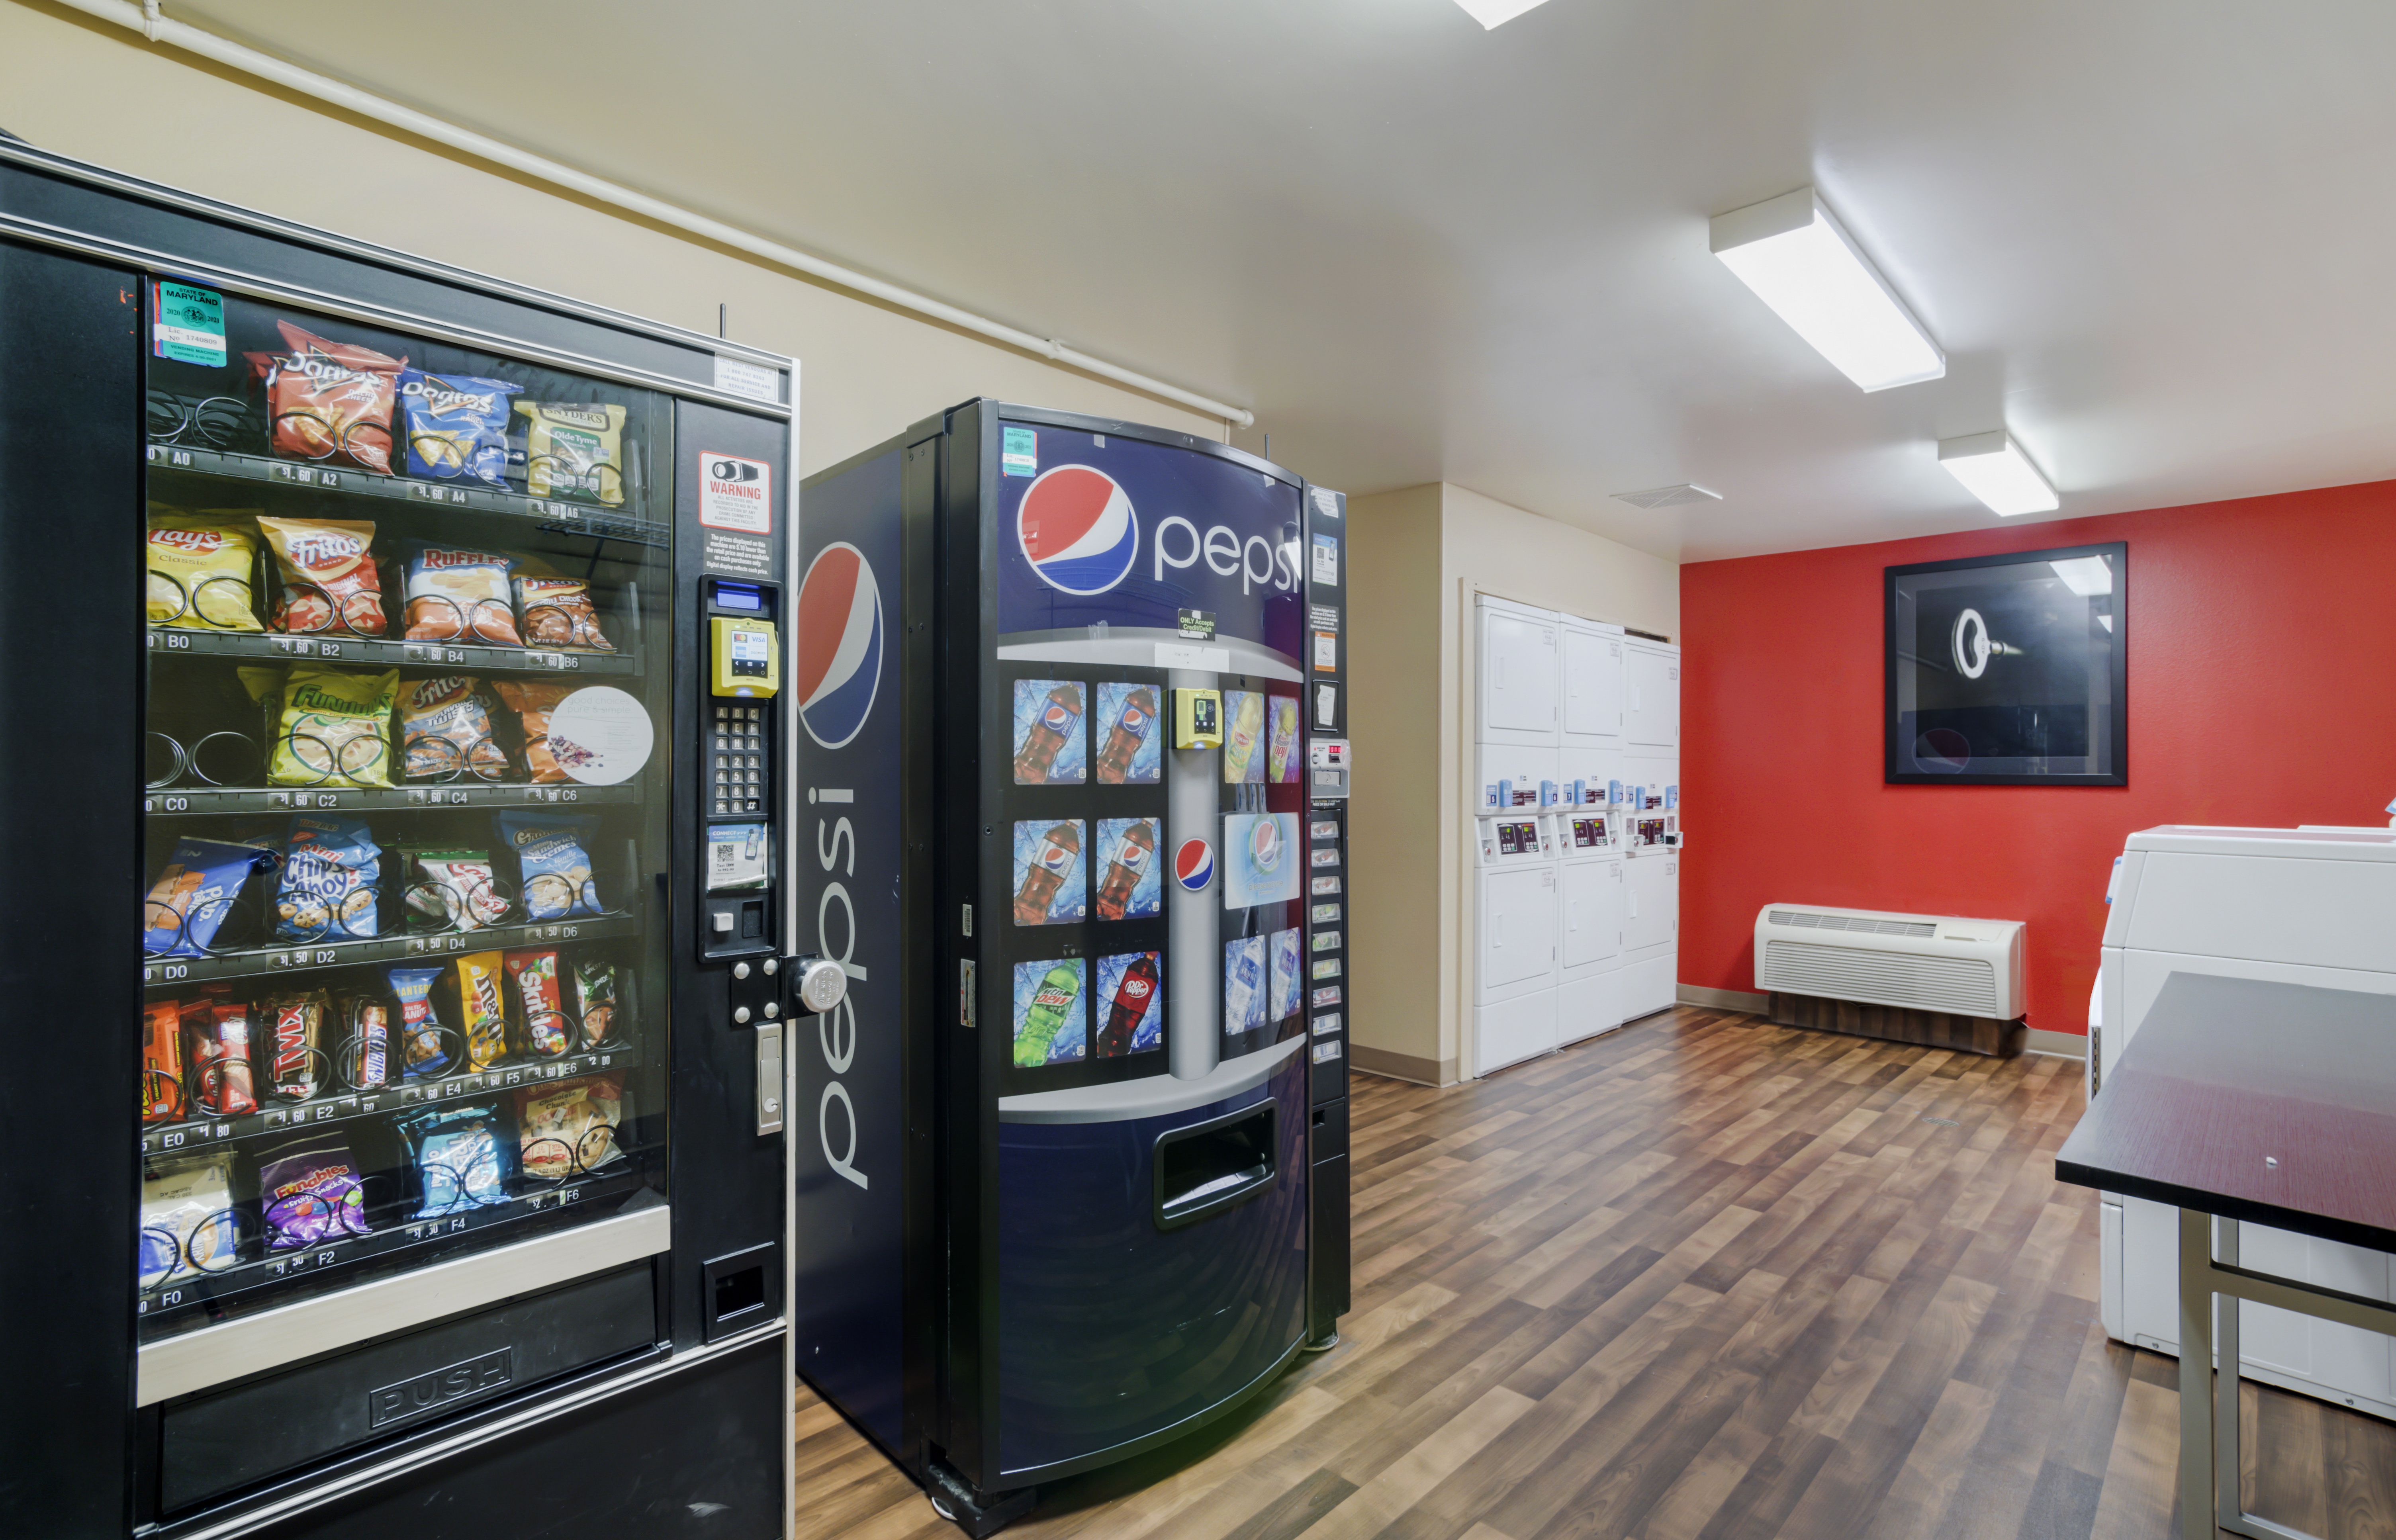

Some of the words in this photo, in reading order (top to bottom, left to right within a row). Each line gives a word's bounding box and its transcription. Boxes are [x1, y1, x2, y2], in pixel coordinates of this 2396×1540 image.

[166, 290, 217, 305] MARYLAND
[186, 335, 217, 344] 1740809
[284, 351, 381, 385] Doritos
[745, 365, 766, 374] VENDORS
[345, 394, 376, 404] CHEESE
[402, 382, 493, 413] Doritos
[546, 409, 602, 423] SNYDER'S
[555, 431, 575, 441] Olde
[576, 434, 597, 445] Tyme
[173, 452, 190, 465] A0
[322, 473, 337, 485] A2
[452, 491, 465, 503] A4
[710, 481, 761, 500] WARNING
[567, 507, 578, 518] A6
[150, 529, 219, 550] Lay's
[286, 531, 362, 568] Fritos
[159, 555, 207, 566] Classic
[423, 549, 509, 568] RUFFLES
[1183, 624, 1212, 632] Credit/Debit
[168, 636, 190, 648] B0
[321, 644, 340, 656] B2
[448, 652, 464, 662] B4
[565, 658, 578, 667] B6
[425, 700, 474, 726] TWISTS
[436, 700, 467, 718] FLAVOR
[1062, 714, 1073, 735] pepsi
[1138, 717, 1148, 737] pepsi
[1235, 732, 1248, 743] Lipton
[319, 795, 337, 806] C2
[452, 793, 467, 803] C4
[563, 790, 577, 800] C6
[166, 798, 187, 810] C0
[301, 819, 318, 828] BIG
[319, 822, 339, 831] BAG
[527, 835, 576, 857] Sandwich
[532, 841, 576, 863] Cremes
[300, 843, 345, 863] Mini
[555, 851, 576, 864] Vanilla
[1062, 853, 1072, 875] pepsi
[1139, 852, 1148, 872] pepsi
[284, 854, 346, 884] Chips
[1249, 883, 1265, 892] please
[563, 926, 577, 937] D6
[450, 938, 466, 949] D4
[317, 951, 335, 963] D2
[166, 966, 187, 978] D0
[808, 789, 868, 1190] pepsi
[1126, 980, 1148, 993] Pepper
[519, 972, 550, 1049] Skittles
[274, 1002, 309, 1083] TWIX
[366, 1024, 387, 1083] SNICKERS
[564, 1063, 577, 1074] E6
[507, 1072, 519, 1084] F5
[446, 1083, 461, 1095] E4
[539, 1092, 576, 1106] Chocolate
[546, 1099, 570, 1110] Chunk
[317, 1106, 333, 1118] E2
[164, 1133, 184, 1147] E0
[274, 1165, 349, 1200] Funables
[315, 1179, 343, 1195] Snacks
[567, 1190, 579, 1201] F6
[452, 1218, 465, 1231] F4
[319, 1251, 335, 1265] F2
[163, 1291, 181, 1305] F0
[379, 1355, 505, 1420] PUSH
